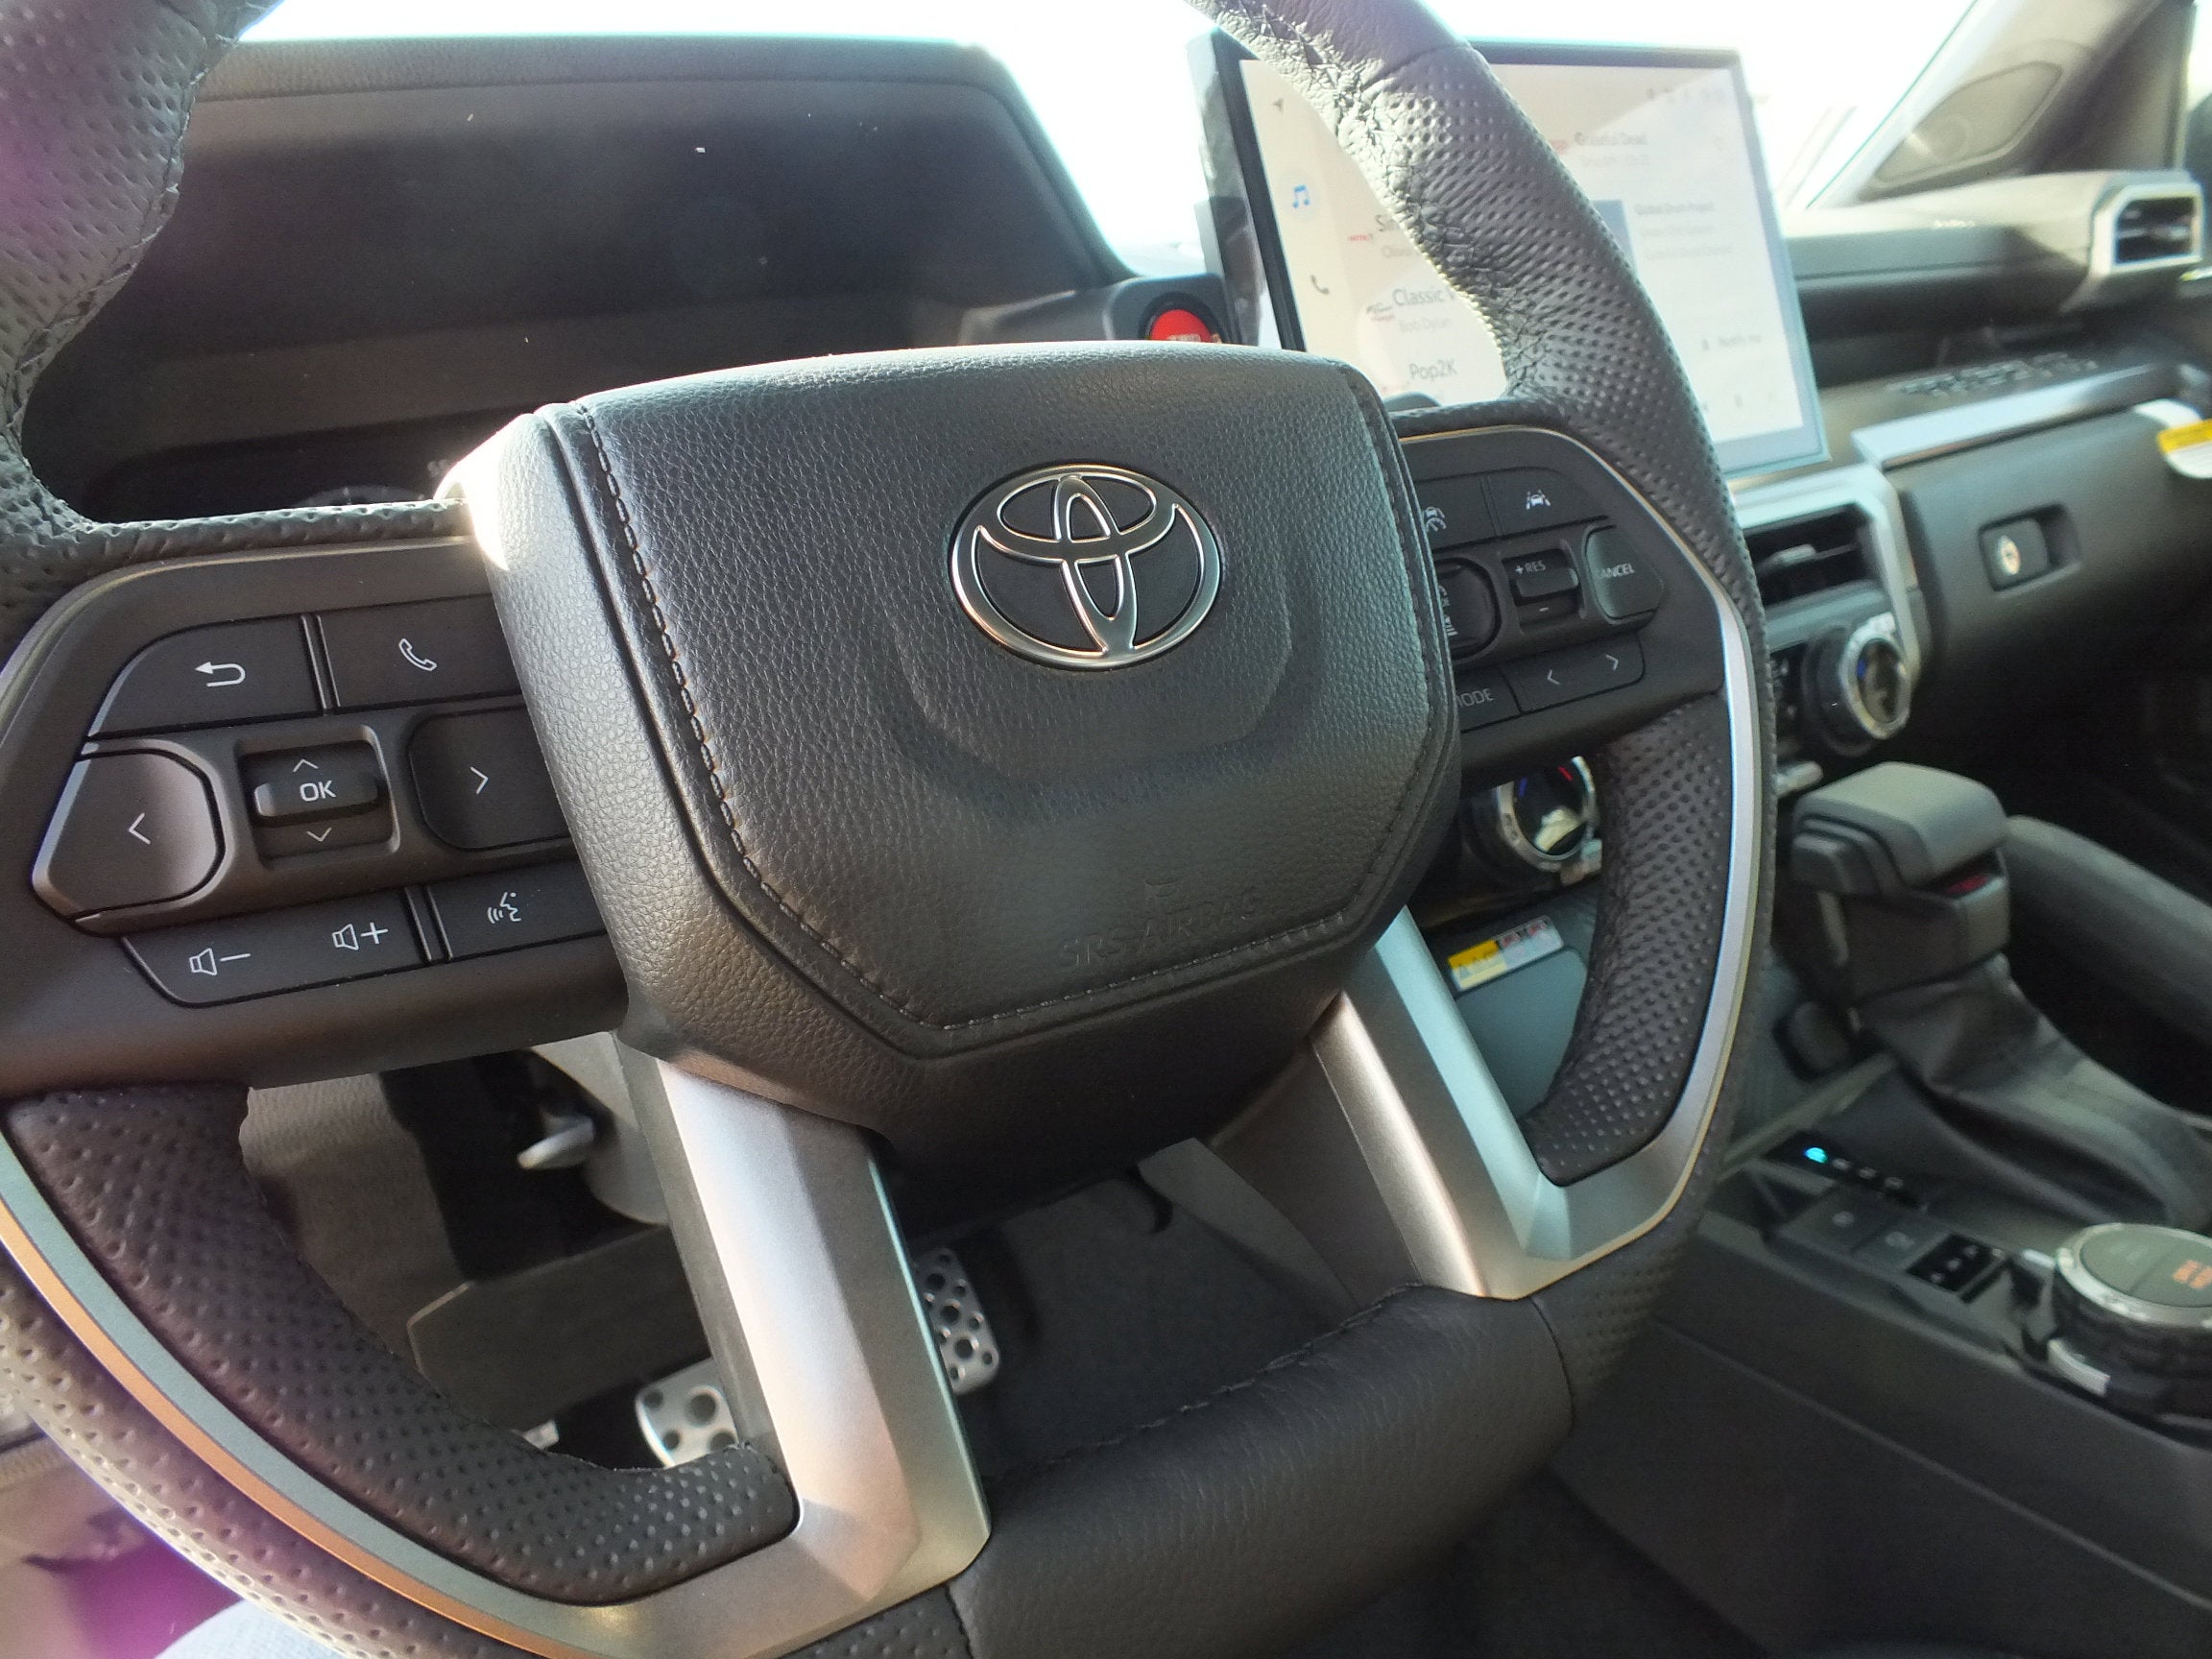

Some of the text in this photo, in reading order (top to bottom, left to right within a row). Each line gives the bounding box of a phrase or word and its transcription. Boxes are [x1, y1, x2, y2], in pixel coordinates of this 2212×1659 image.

[1392, 288, 1444, 306] Classic
[1408, 359, 1457, 381] Pop2K
[1597, 563, 1635, 579] ANCEL
[300, 780, 337, 803] OK
